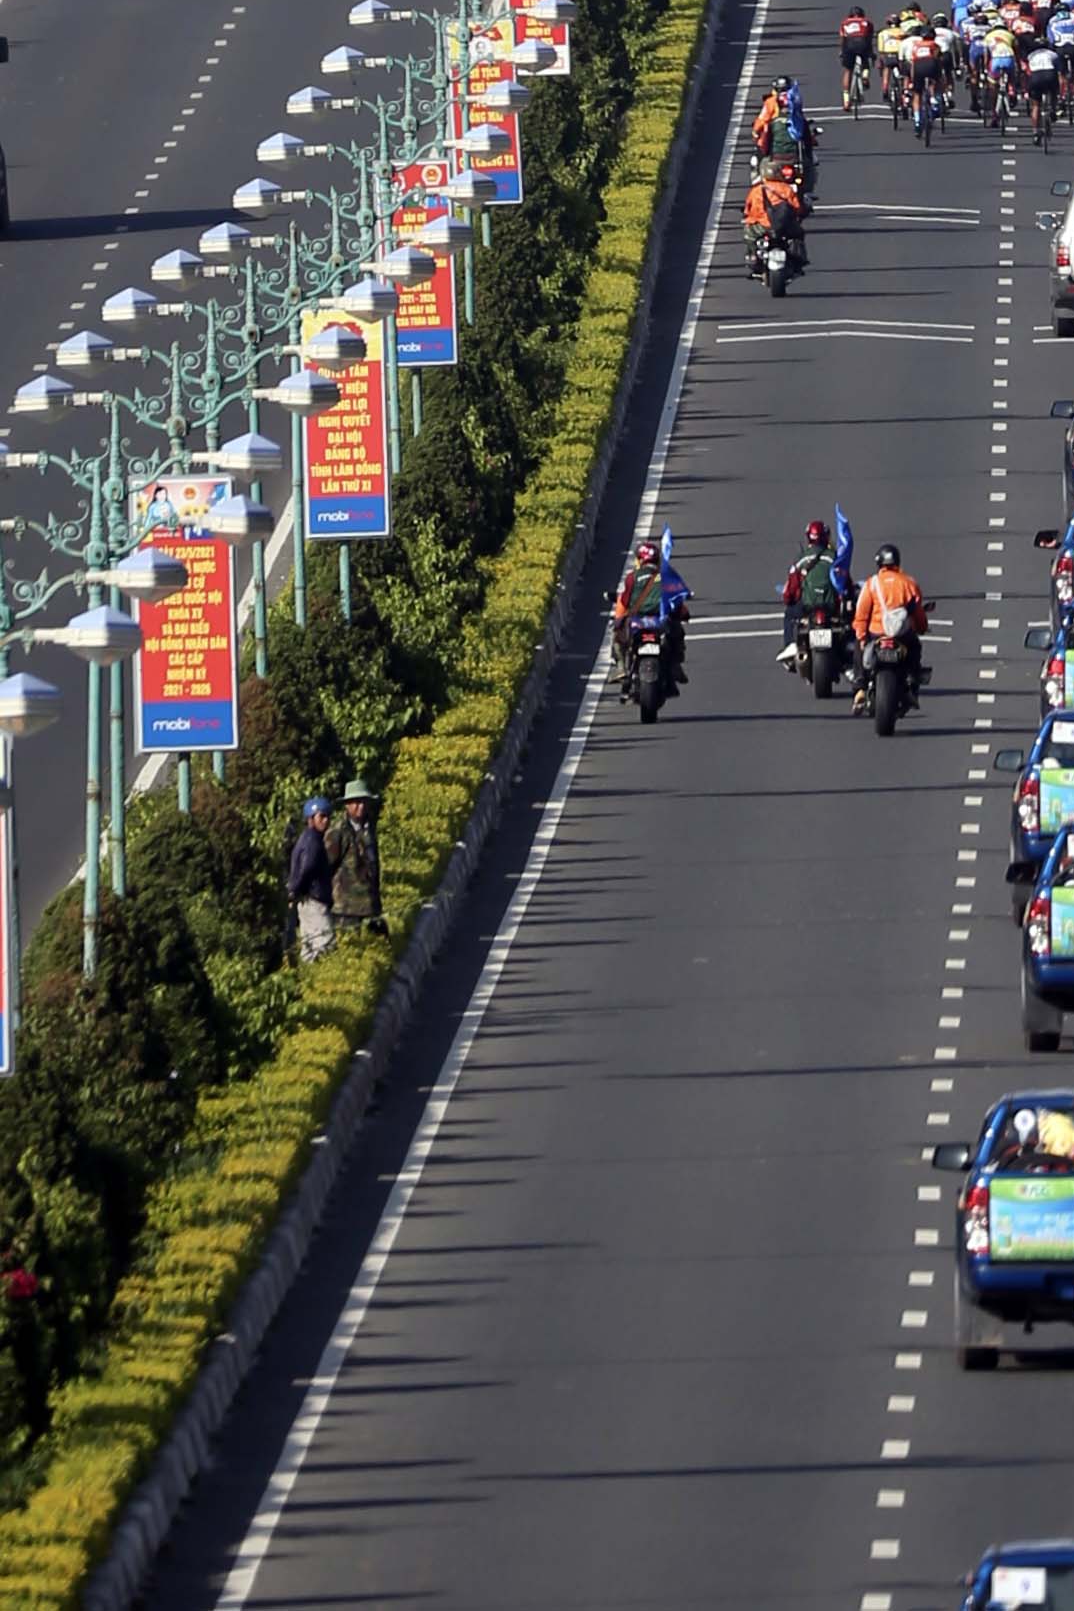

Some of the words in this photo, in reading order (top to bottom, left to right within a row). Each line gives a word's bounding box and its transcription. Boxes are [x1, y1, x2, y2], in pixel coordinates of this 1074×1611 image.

[348, 363, 369, 378] TÂM
[341, 411, 371, 428] QUYẾT
[345, 429, 363, 446] HỘI
[333, 462, 354, 477] LÂM
[361, 478, 372, 493] XI
